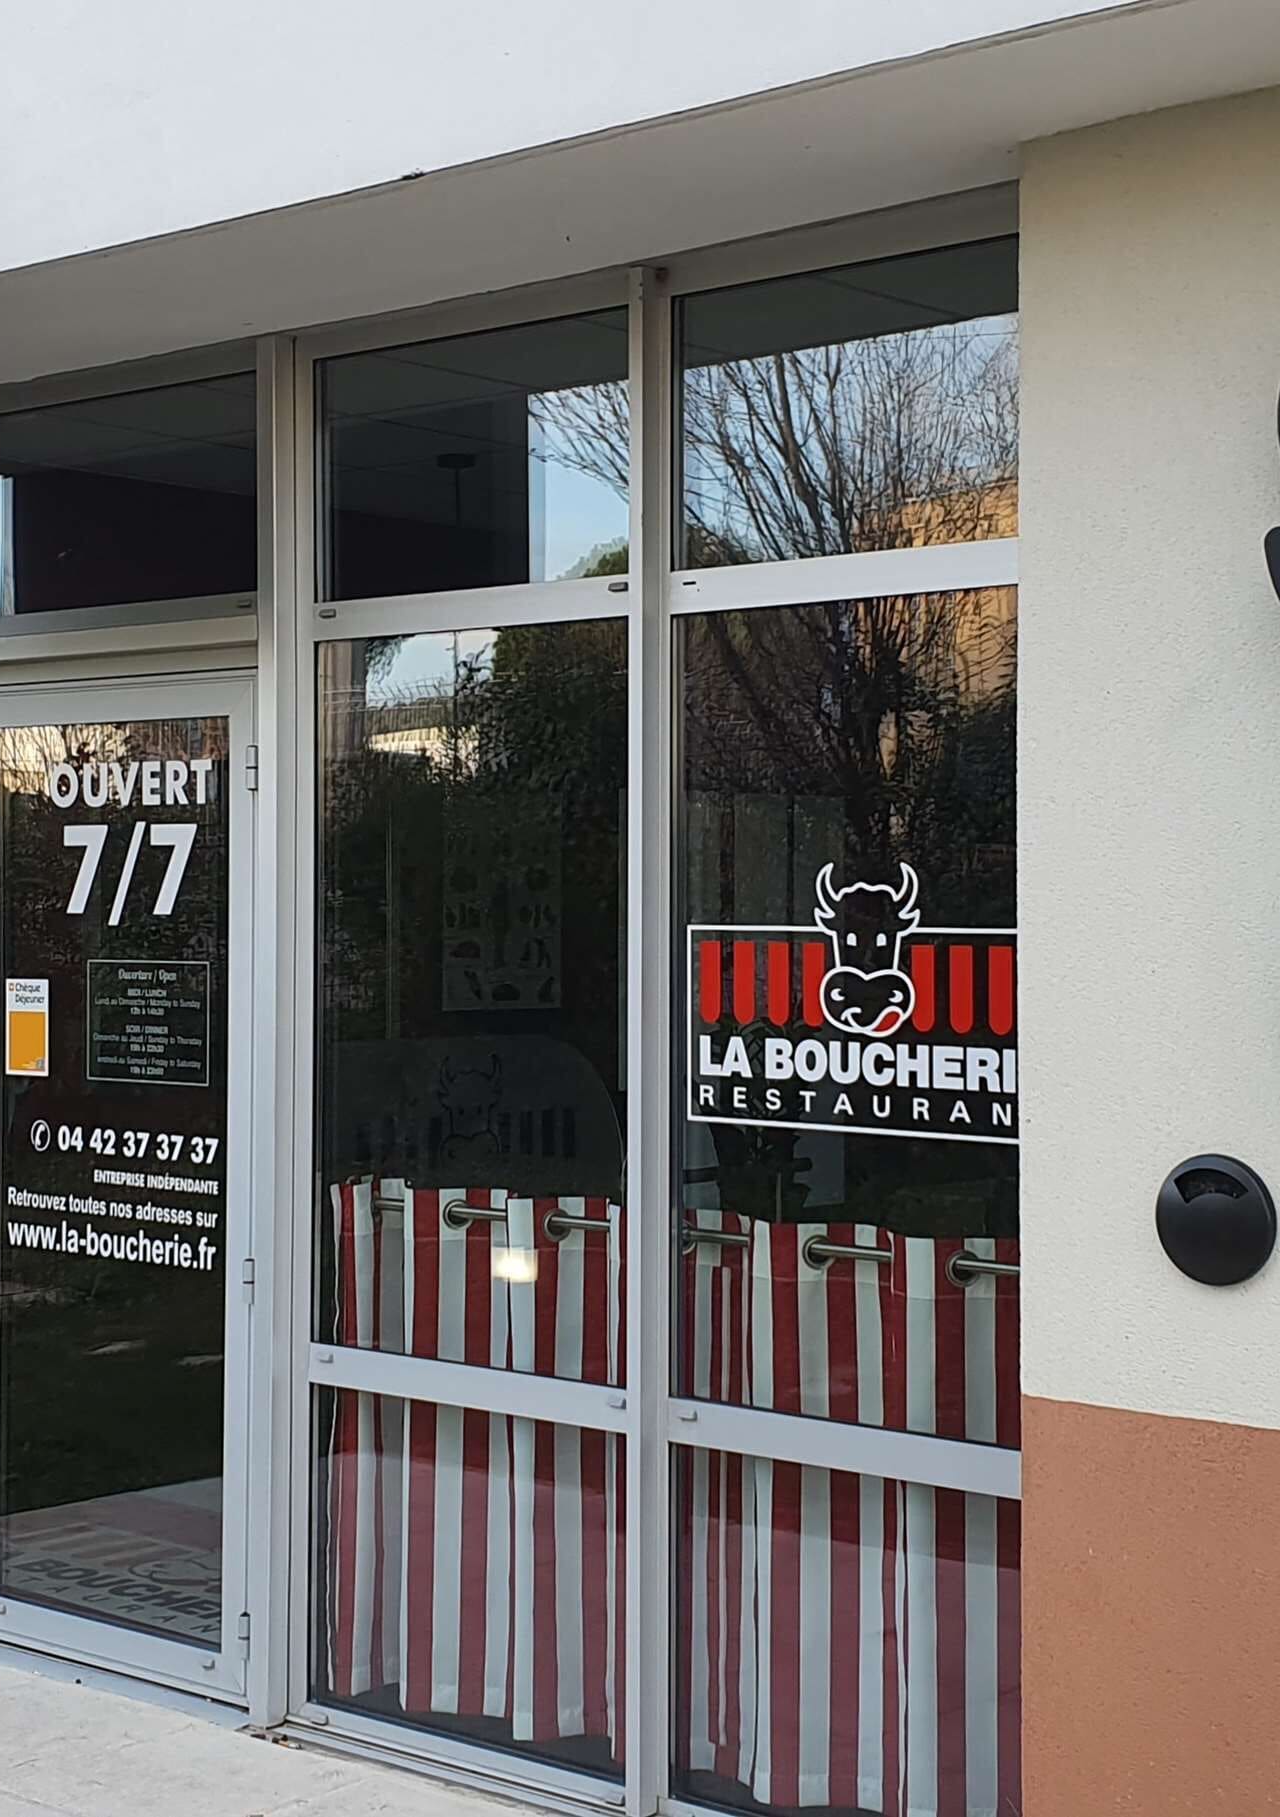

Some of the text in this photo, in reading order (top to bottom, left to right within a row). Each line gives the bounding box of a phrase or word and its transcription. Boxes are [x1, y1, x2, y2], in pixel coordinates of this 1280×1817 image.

[49, 759, 213, 808] OUVERT
[63, 821, 198, 926] 7/7
[699, 1035, 1017, 1094] LA BOUCHERI
[699, 1085, 1013, 1126] RESTAURAN
[57, 1125, 219, 1164] 04 42 37 37 37
[93, 1169, 219, 1195] ENTREPRISE INDÉPENDANTE
[7, 1186, 218, 1229] Retrouvez toutes nos adresses sur
[7, 1220, 217, 1271] www.la-boucherie.fr
[13, 1558, 222, 1622] BOUCHE
[22, 1574, 221, 1634] TAURAN
